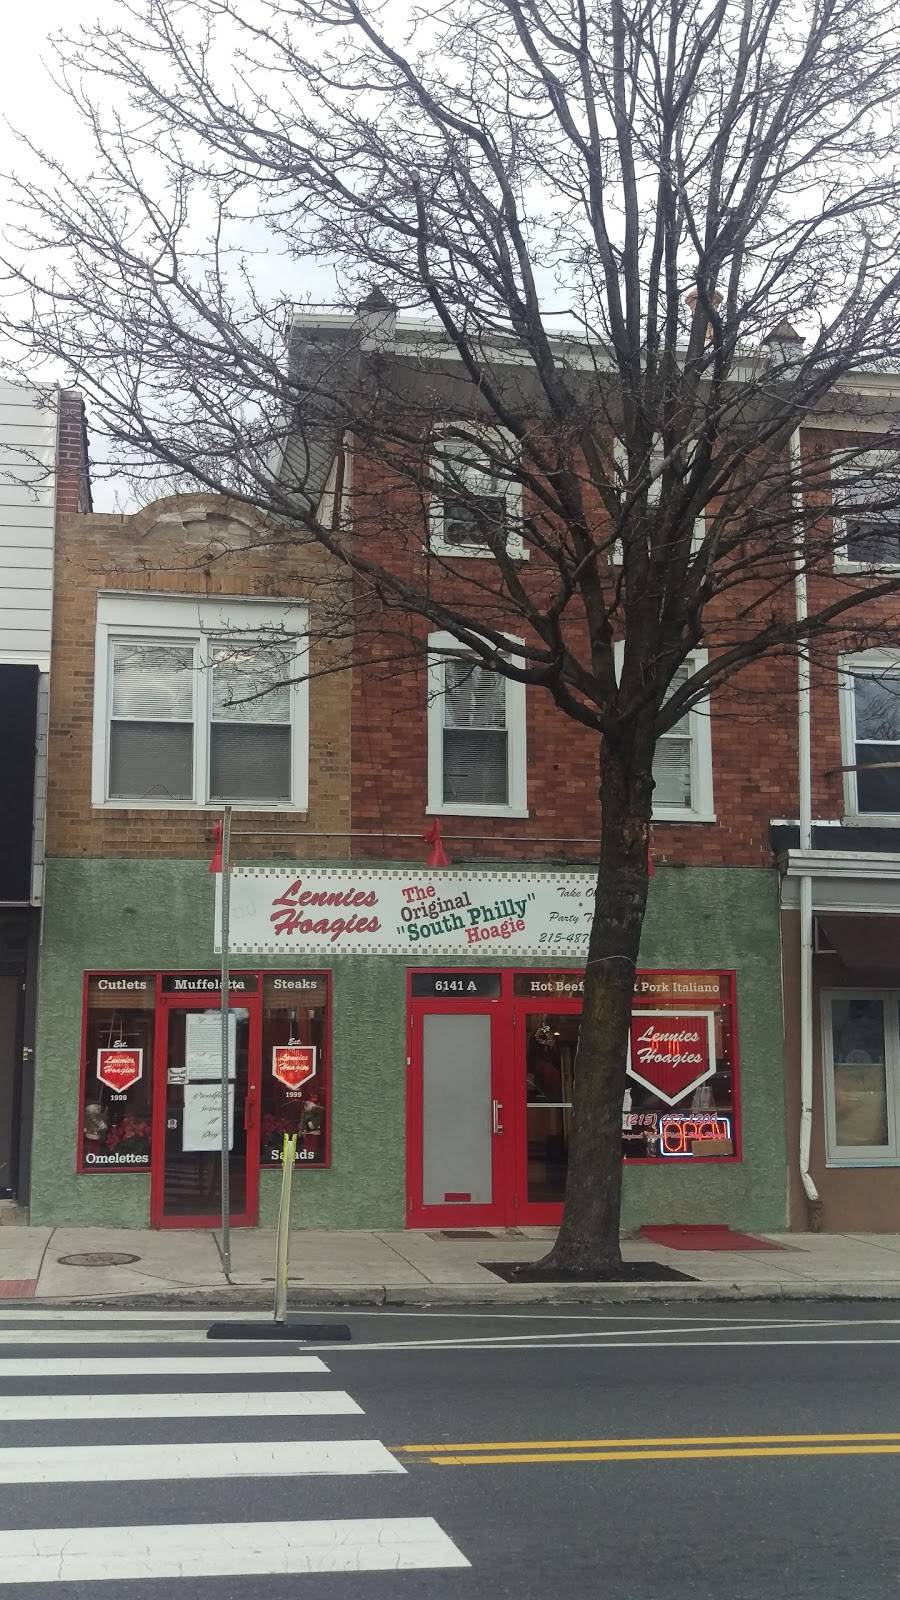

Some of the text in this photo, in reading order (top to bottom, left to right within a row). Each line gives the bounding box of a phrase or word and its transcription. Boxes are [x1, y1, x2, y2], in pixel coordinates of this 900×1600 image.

[272, 880, 379, 907] Lennies
[401, 885, 436, 903] The
[557, 888, 581, 897] Take
[400, 891, 472, 922] Original
[396, 892, 536, 941] "South Philly"
[549, 912, 579, 924] Party
[270, 908, 382, 942] Hoagies
[464, 917, 526, 943] Hoagie
[539, 932, 590, 943] 215-487
[98, 979, 147, 990] Cutlets
[174, 979, 245, 990] Muffeltta
[273, 979, 317, 989] Steaks
[435, 980, 477, 991] 6141 A
[530, 981, 584, 992] Hot Beef
[641, 982, 670, 992] Pork
[673, 982, 720, 993] Italiano
[637, 1026, 699, 1042] Lennies
[637, 1047, 703, 1068] Hoagies
[86, 1152, 149, 1164] Omelettes
[271, 1149, 315, 1160] Saads
